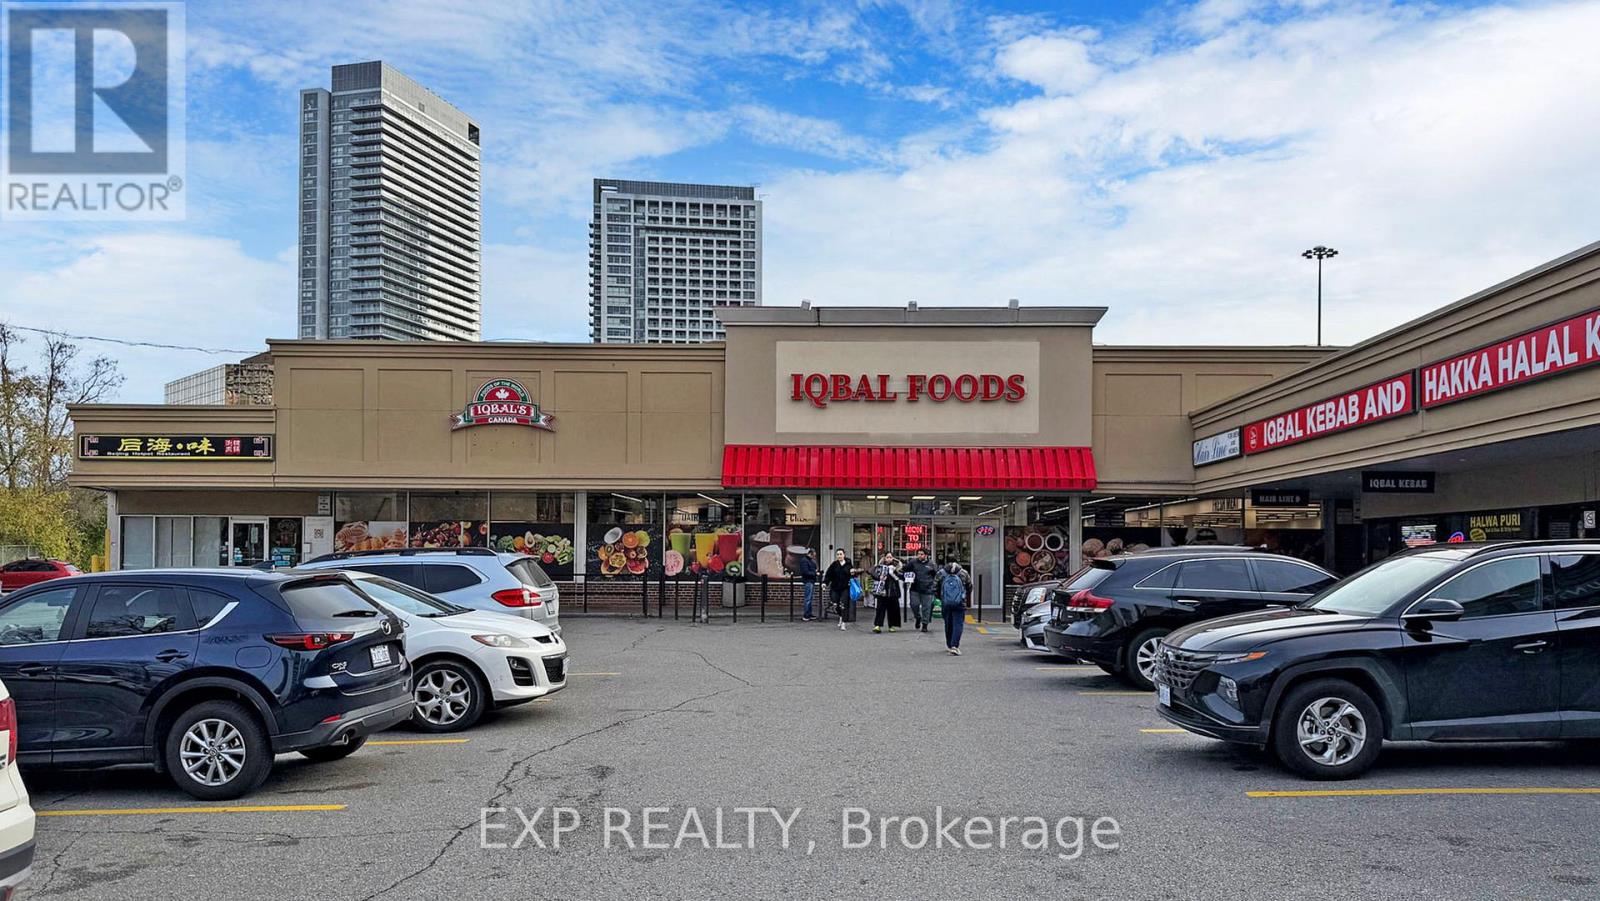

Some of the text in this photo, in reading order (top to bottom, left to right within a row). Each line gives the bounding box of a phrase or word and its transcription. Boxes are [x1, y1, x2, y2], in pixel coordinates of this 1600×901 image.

[1425, 352, 1493, 402] HAKKA
[1498, 325, 1578, 383] HALAL
[791, 373, 1026, 408] IQBAL FOODS
[477, 404, 527, 415] IQBAL'S
[1263, 412, 1303, 446] IQBAL
[1306, 394, 1360, 434] KEBAB
[1364, 380, 1406, 420] AND
[1369, 479, 1428, 488] IQBAL KEBAB
[1470, 513, 1521, 528] HALWA PURI
[908, 534, 919, 542] TO
